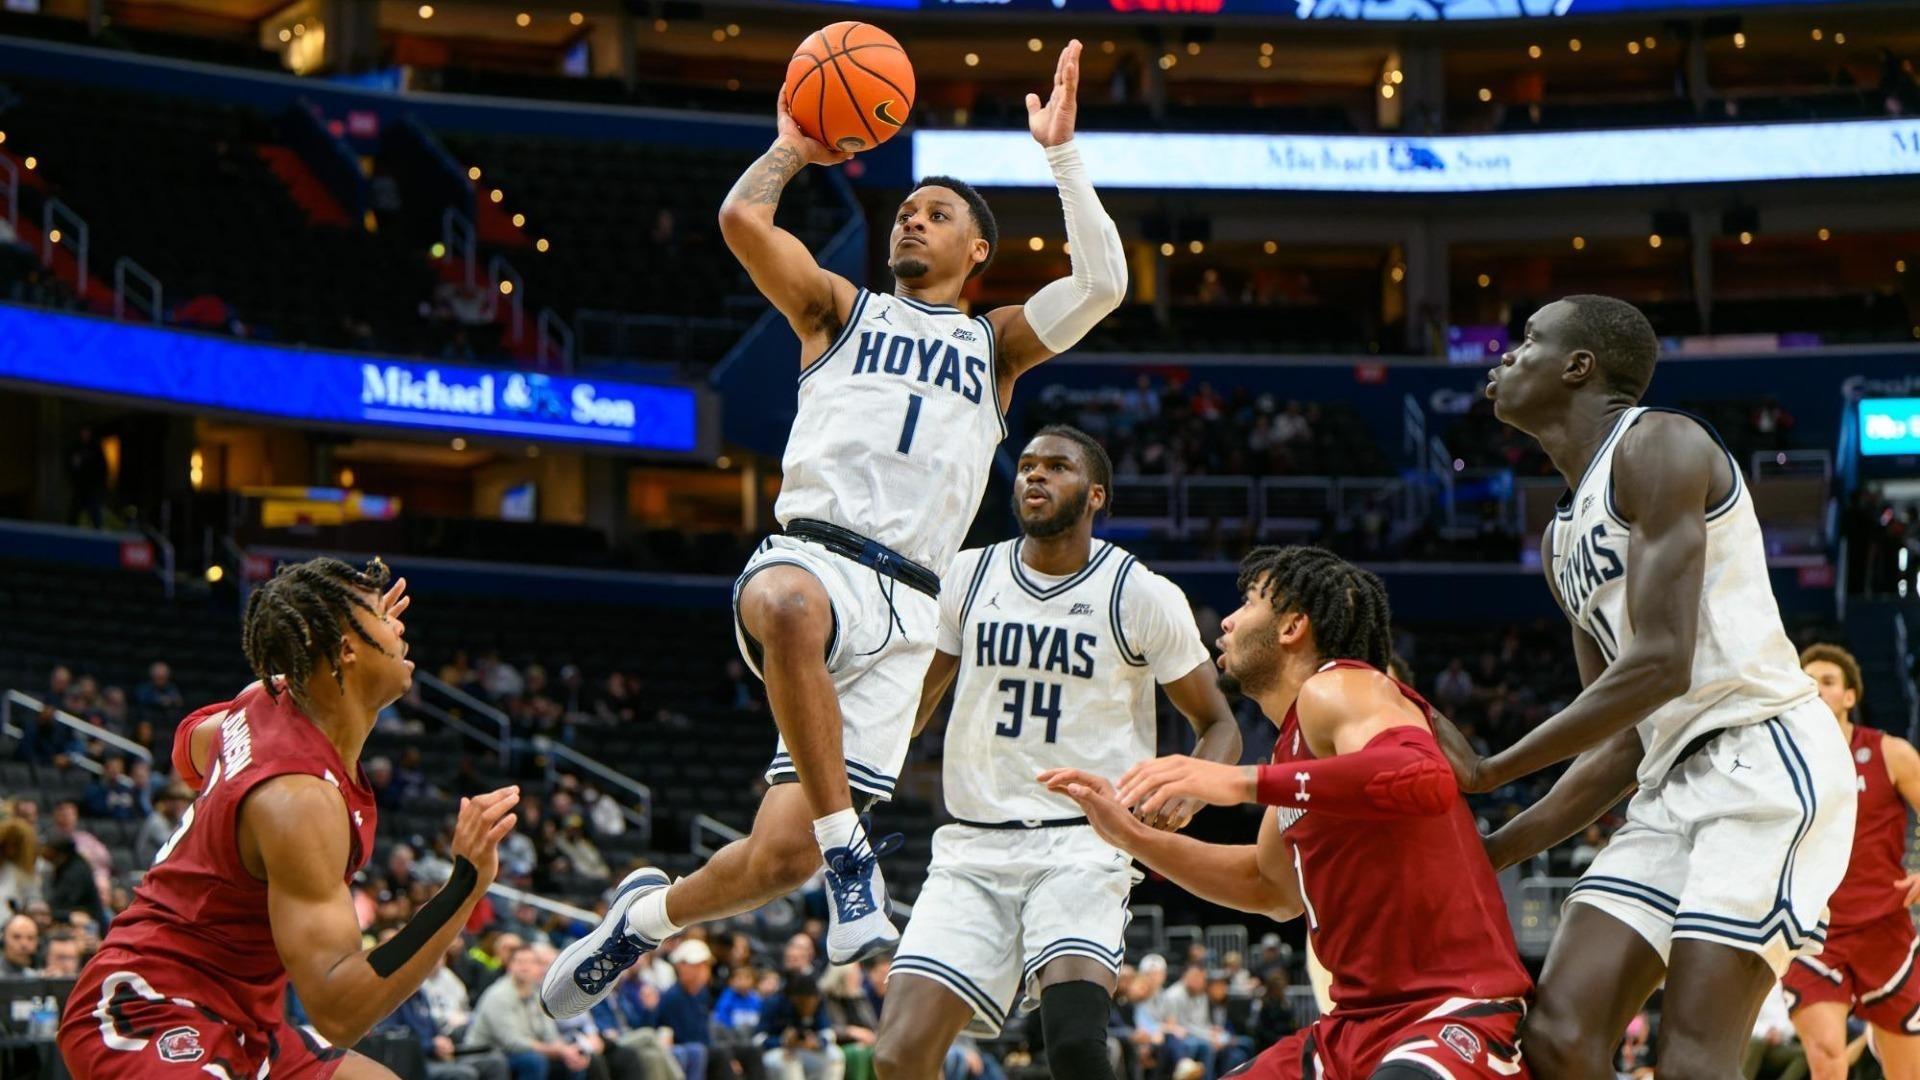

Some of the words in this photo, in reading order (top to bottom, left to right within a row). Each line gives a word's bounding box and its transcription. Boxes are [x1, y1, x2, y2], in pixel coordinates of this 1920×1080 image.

[361, 363, 496, 416] Michael
[571, 383, 635, 428] Son
[852, 331, 986, 405] HOYAS
[897, 393, 923, 454] 1
[976, 621, 1097, 679] HOYAS
[995, 677, 1063, 744] 34
